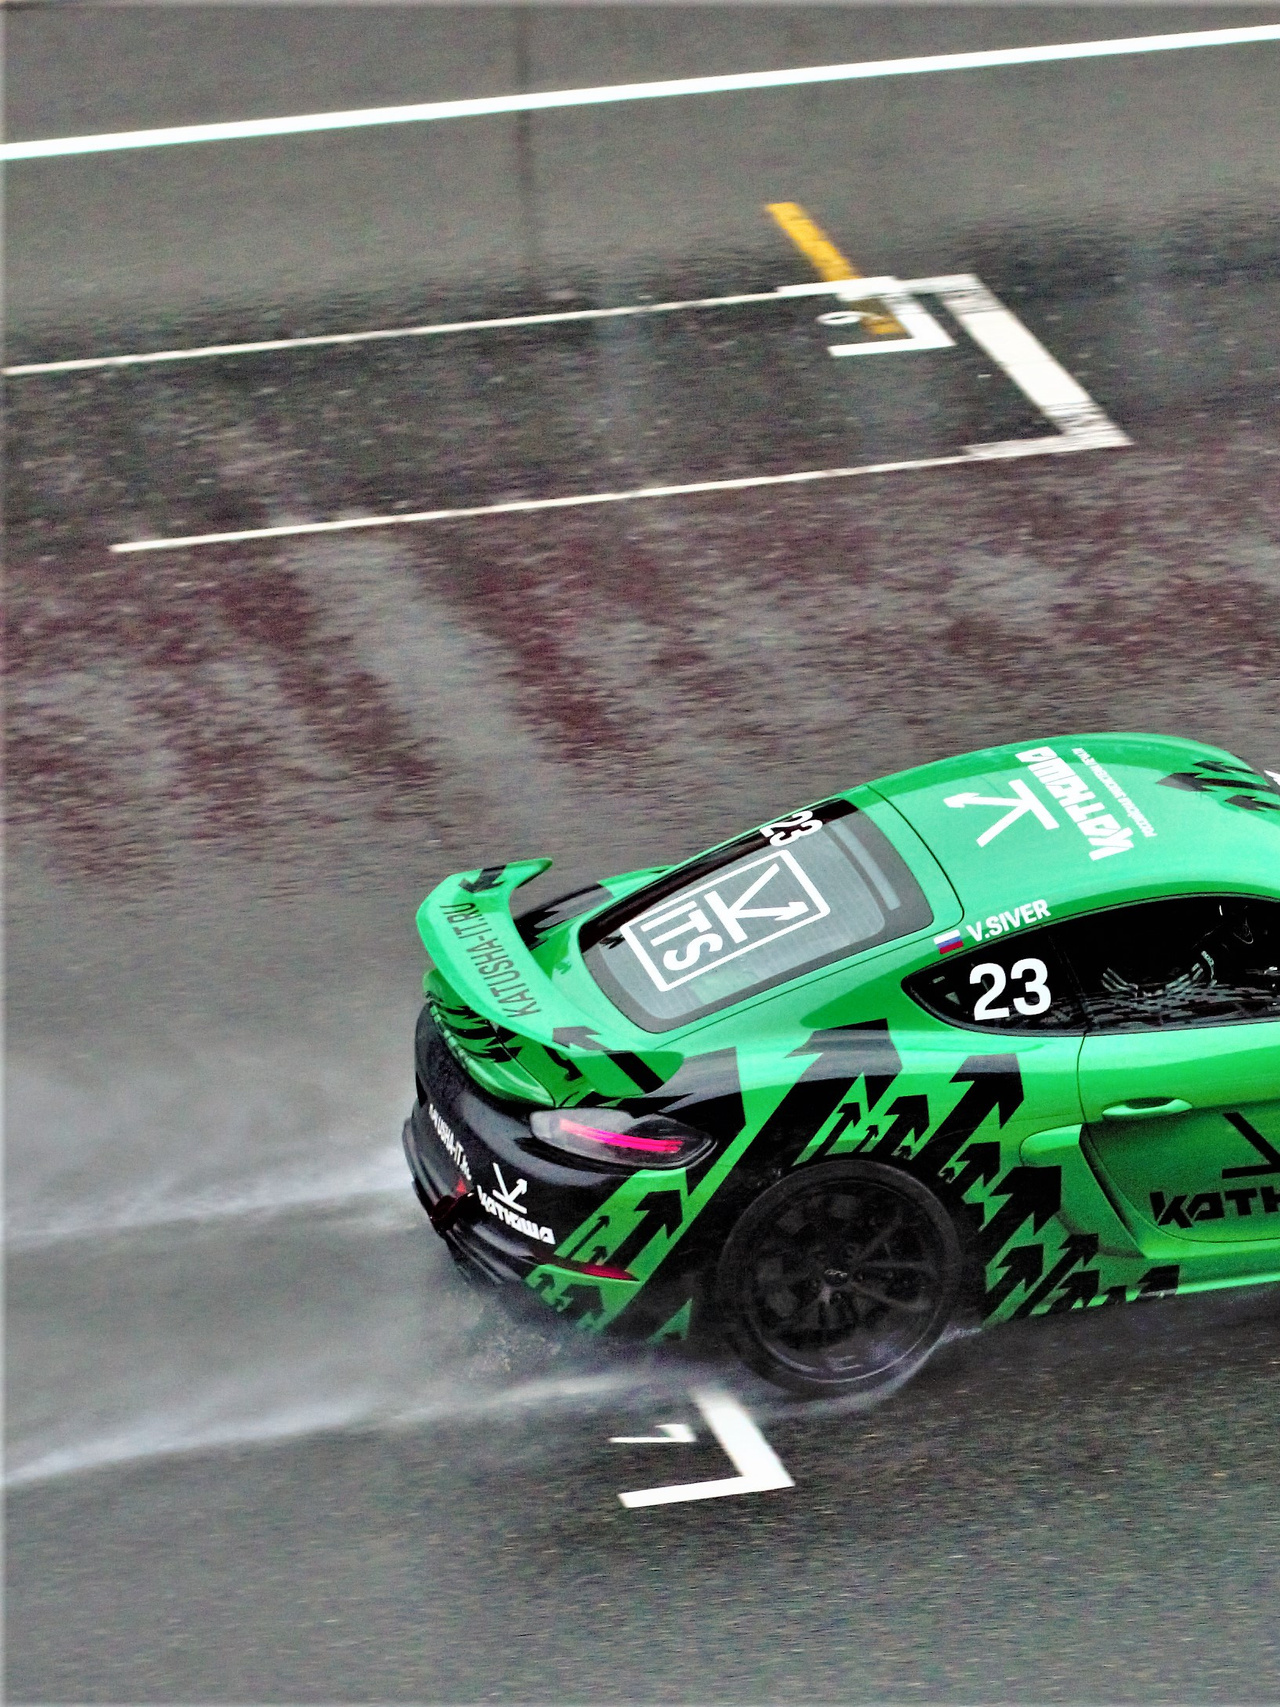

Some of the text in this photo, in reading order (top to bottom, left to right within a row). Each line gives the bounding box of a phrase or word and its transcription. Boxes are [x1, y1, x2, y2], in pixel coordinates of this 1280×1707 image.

[760, 811, 823, 846] 23
[640, 901, 723, 971] ITS
[966, 899, 1051, 942] V.SIVER
[440, 903, 541, 1017] KATUSHA-IT.RU
[969, 958, 1051, 1021] 23
